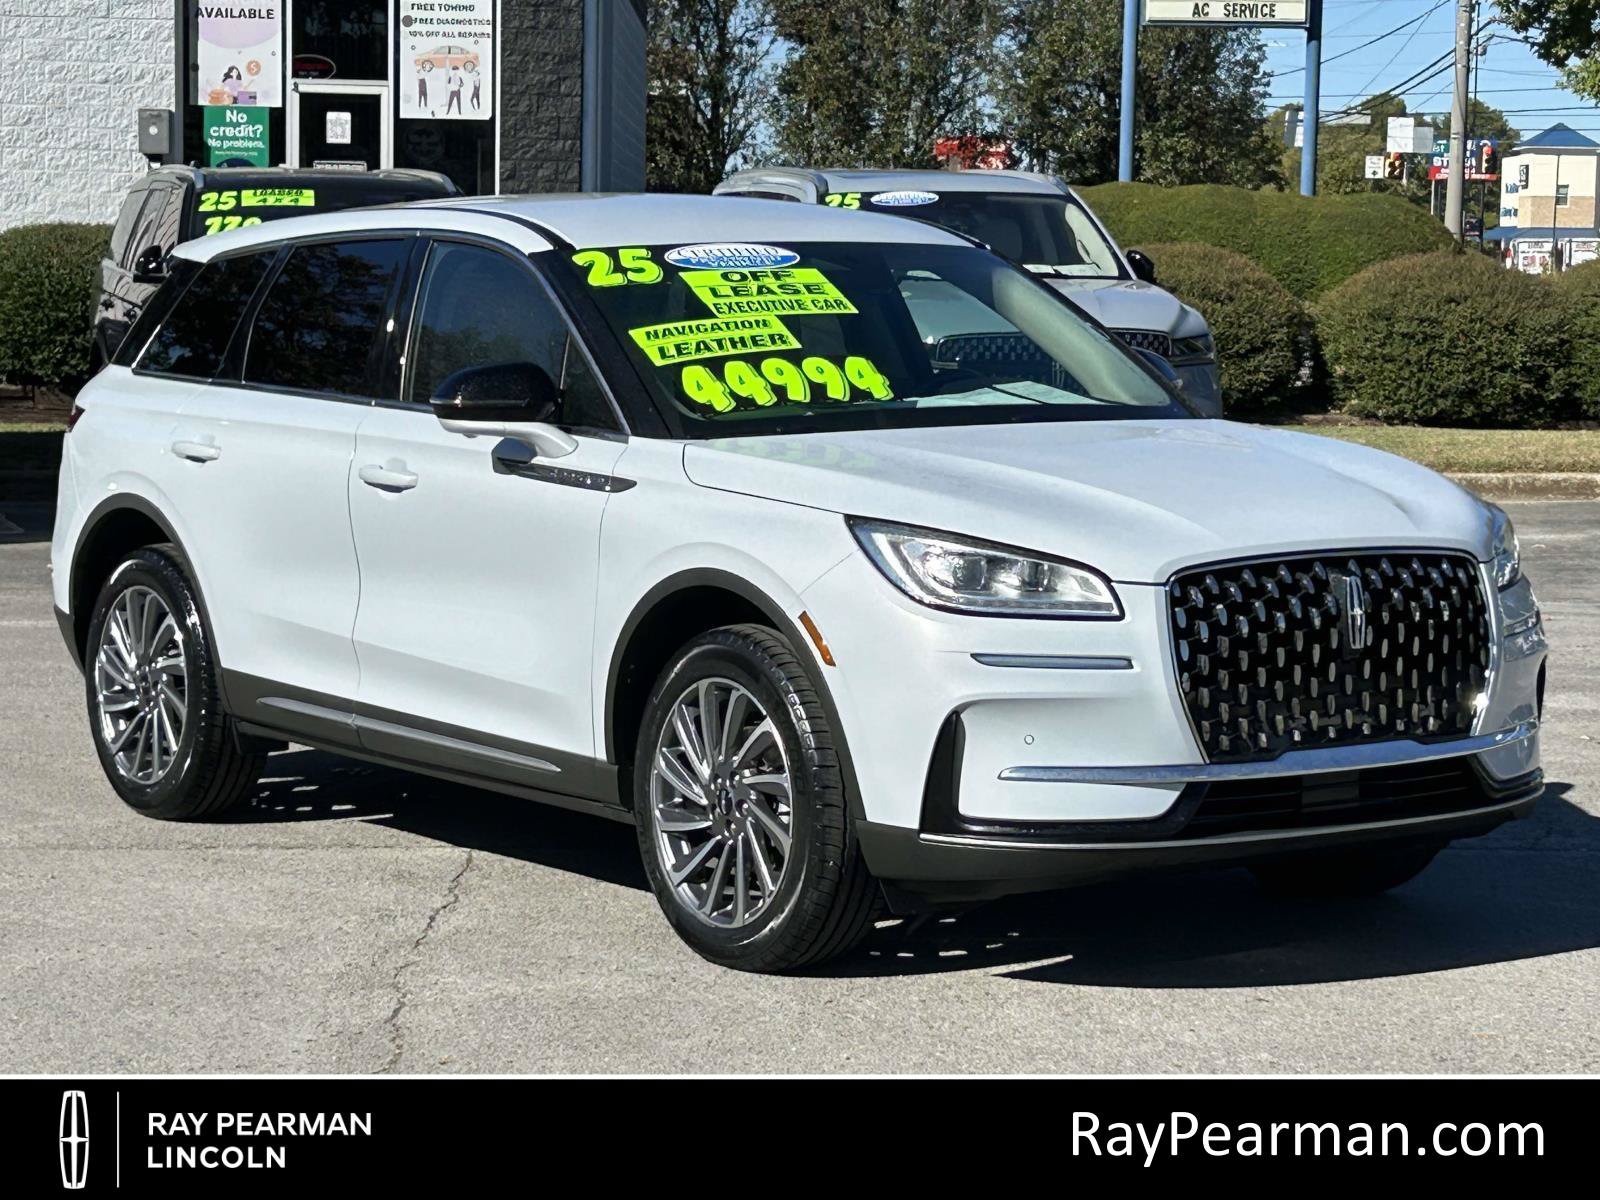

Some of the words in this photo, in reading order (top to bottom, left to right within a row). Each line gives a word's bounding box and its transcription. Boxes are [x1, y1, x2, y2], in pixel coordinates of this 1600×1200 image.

[195, 7, 275, 19] AVAILABLE
[411, 3, 434, 11] FREE
[1192, 3, 1209, 17] AC
[1223, 3, 1276, 18] SERVICE
[226, 109, 248, 123] No
[210, 124, 263, 138] credit?
[208, 138, 222, 147] No
[198, 191, 238, 212] 25
[825, 192, 862, 210] 25
[571, 248, 663, 288] 25
[720, 270, 796, 283] OFF
[709, 283, 826, 299] LEASE
[713, 298, 808, 316] EXECUTIVE
[811, 297, 849, 311] CAR
[645, 319, 774, 342] NAVIGATION
[657, 333, 792, 360] LEATHER
[681, 355, 895, 413] 44994
